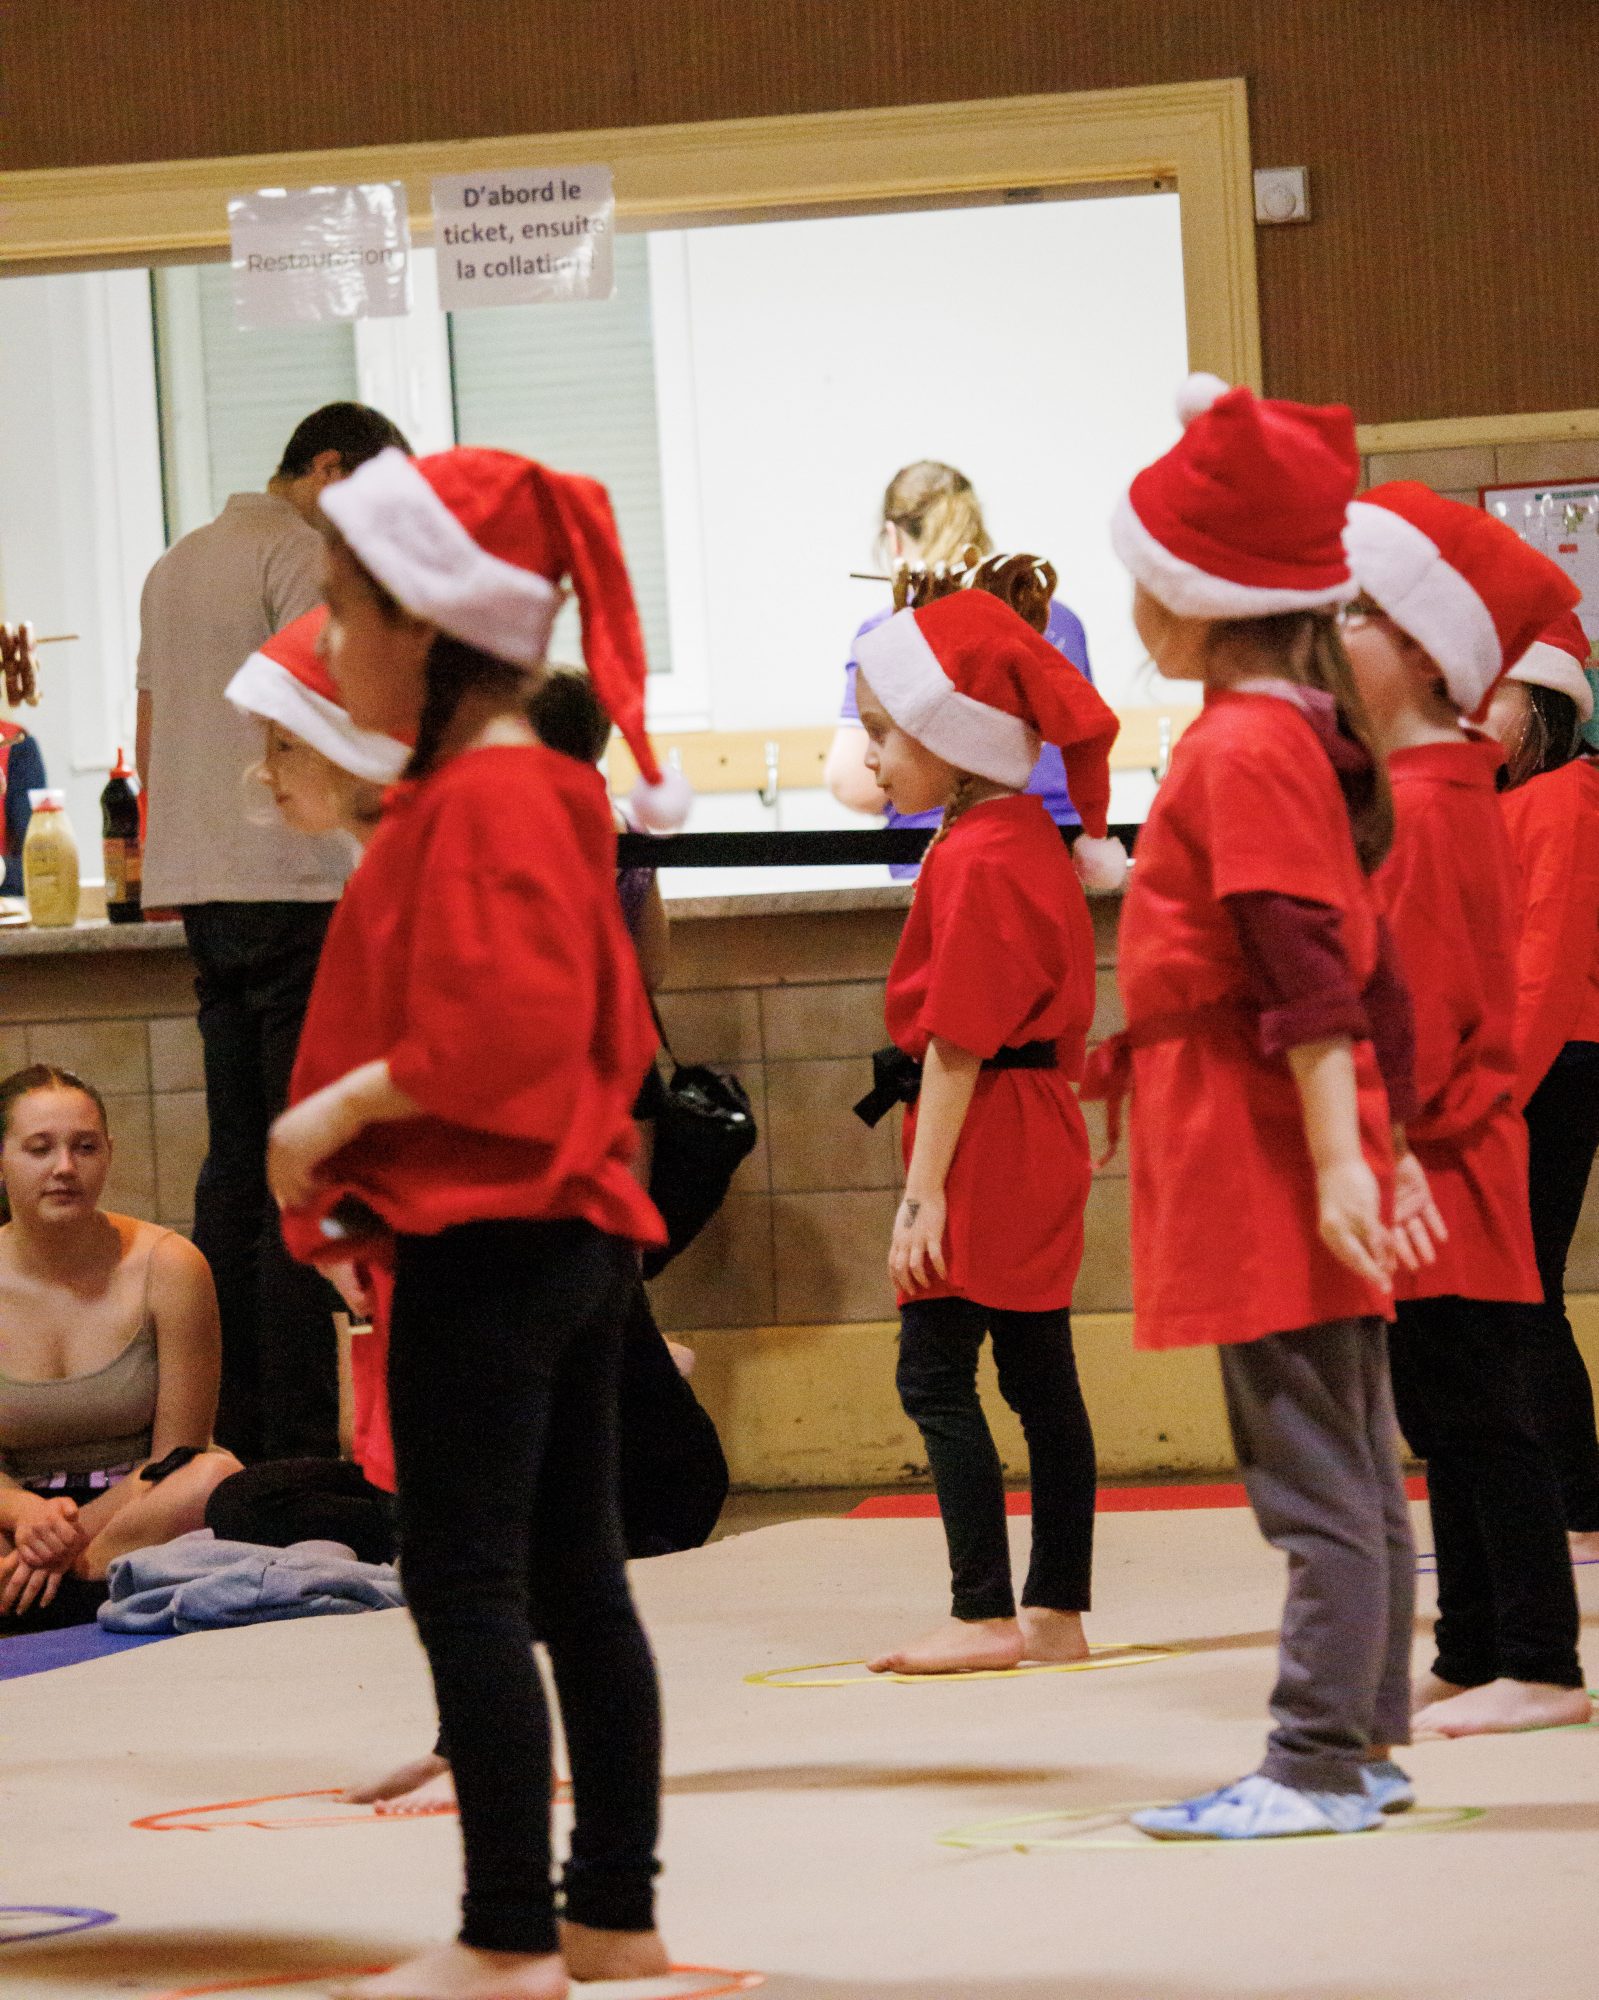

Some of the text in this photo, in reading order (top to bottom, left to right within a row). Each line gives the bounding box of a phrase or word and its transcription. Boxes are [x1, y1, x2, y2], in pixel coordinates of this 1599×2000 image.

[463, 178, 582, 208] D'abord le
[443, 222, 515, 245] ticket,
[456, 258, 476, 281] la
[483, 252, 580, 279] collati
